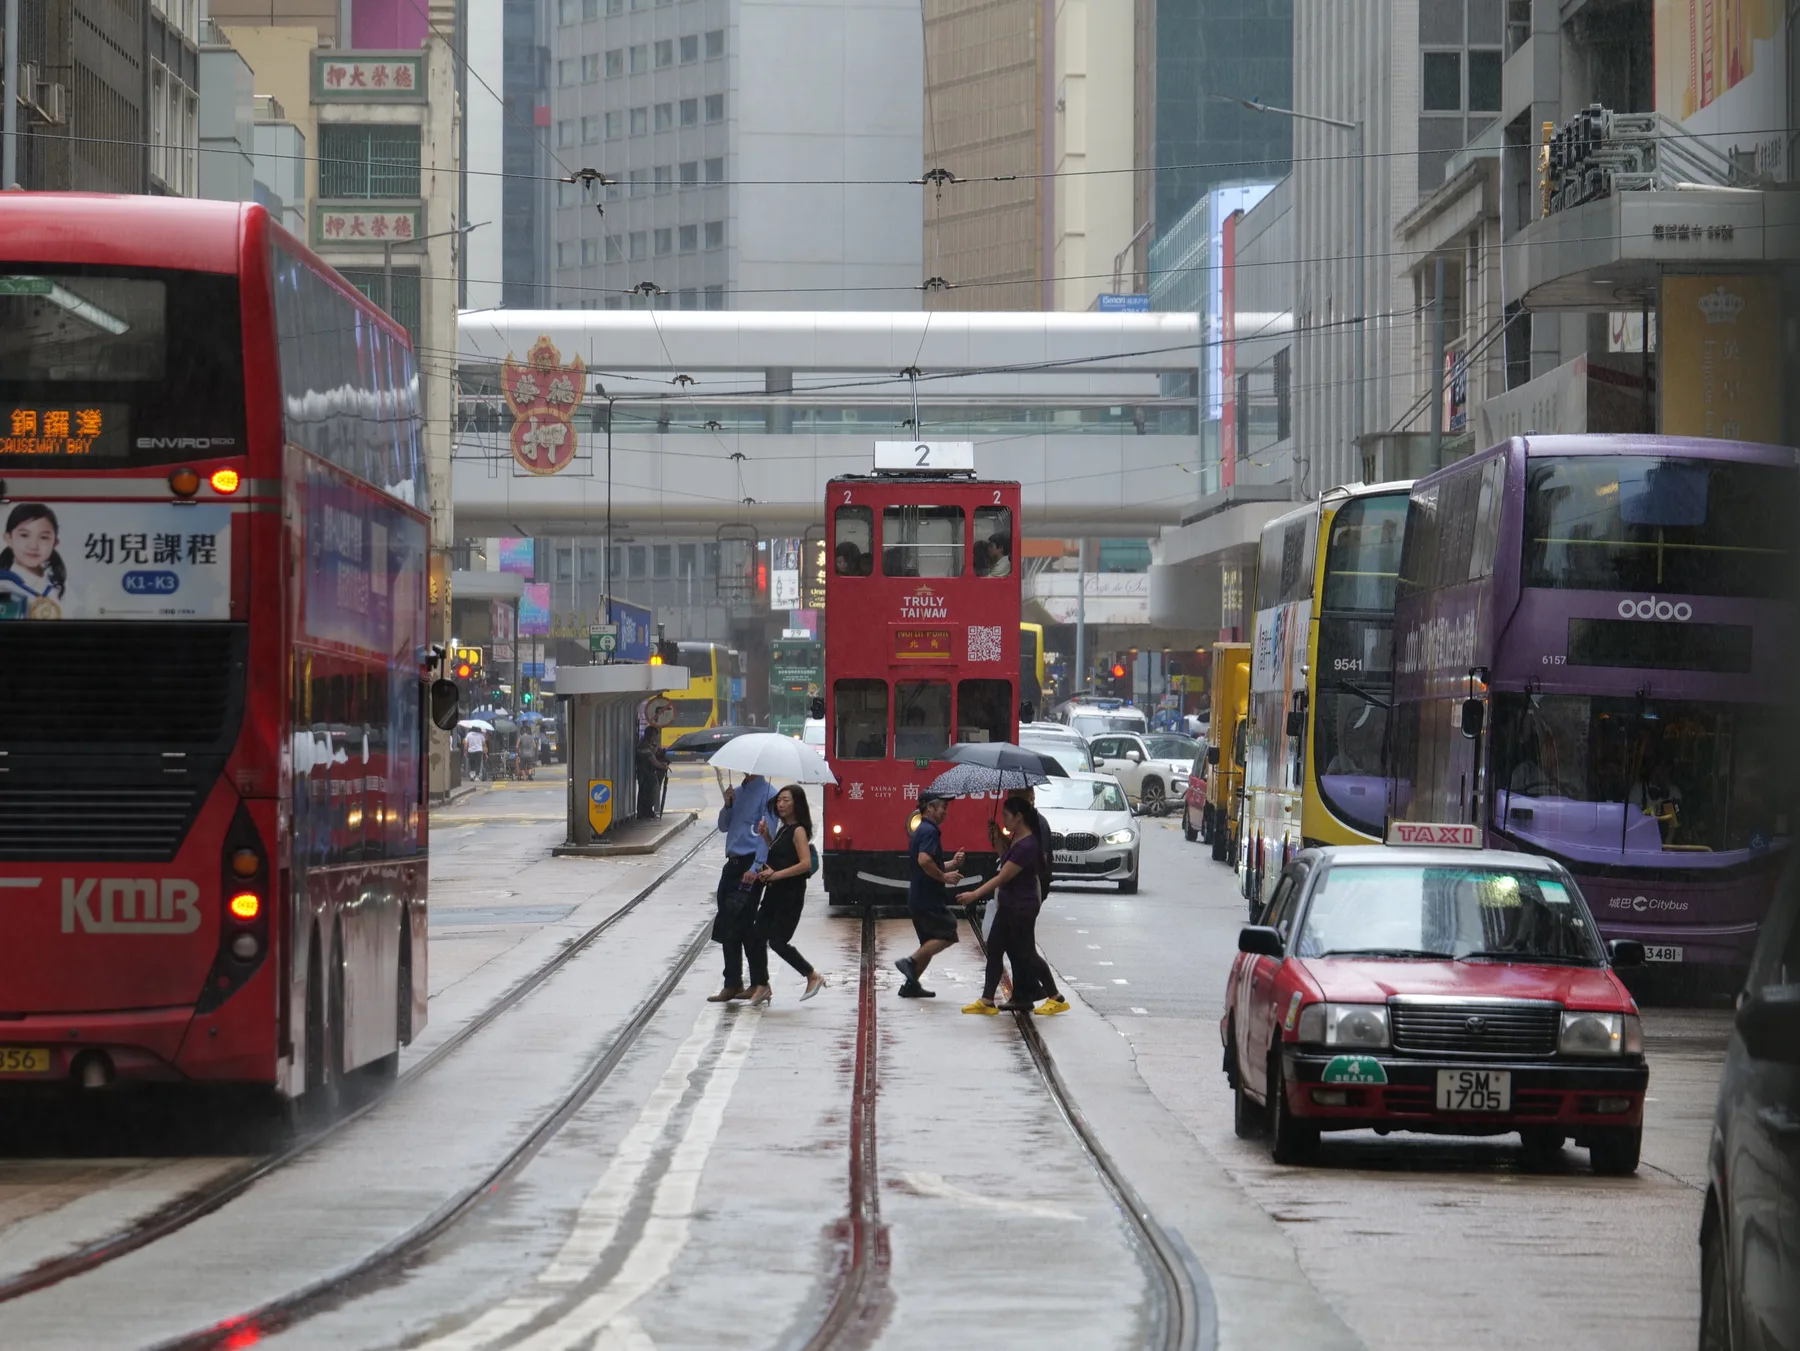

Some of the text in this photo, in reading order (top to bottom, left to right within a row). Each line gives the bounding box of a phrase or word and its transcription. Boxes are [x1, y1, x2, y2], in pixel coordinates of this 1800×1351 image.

[11, 409, 102, 438] 銅鑼灣
[66, 438, 92, 454] BAY
[914, 444, 930, 467] 2
[843, 490, 852, 504] 2
[992, 490, 1001, 504] 2
[84, 532, 217, 565] 幼兒課程
[126, 576, 175, 590] K1-K3
[903, 597, 944, 607] TRULY
[1618, 595, 1692, 621] odoo
[900, 607, 947, 619] TAIWAN
[790, 629, 801, 637] 29
[1334, 659, 1362, 671] 9541
[1542, 655, 1566, 665] 6157
[848, 782, 864, 800] 臺
[902, 783, 920, 800] 南
[1398, 825, 1473, 844] TAXI
[61, 878, 202, 934] KMB
[1608, 897, 1689, 910] 城巴 Citybus
[1347, 1061, 1360, 1074] 4
[1335, 1074, 1374, 1082] SEATS
[1459, 1071, 1490, 1091] SM
[1446, 1090, 1501, 1109] 1705
